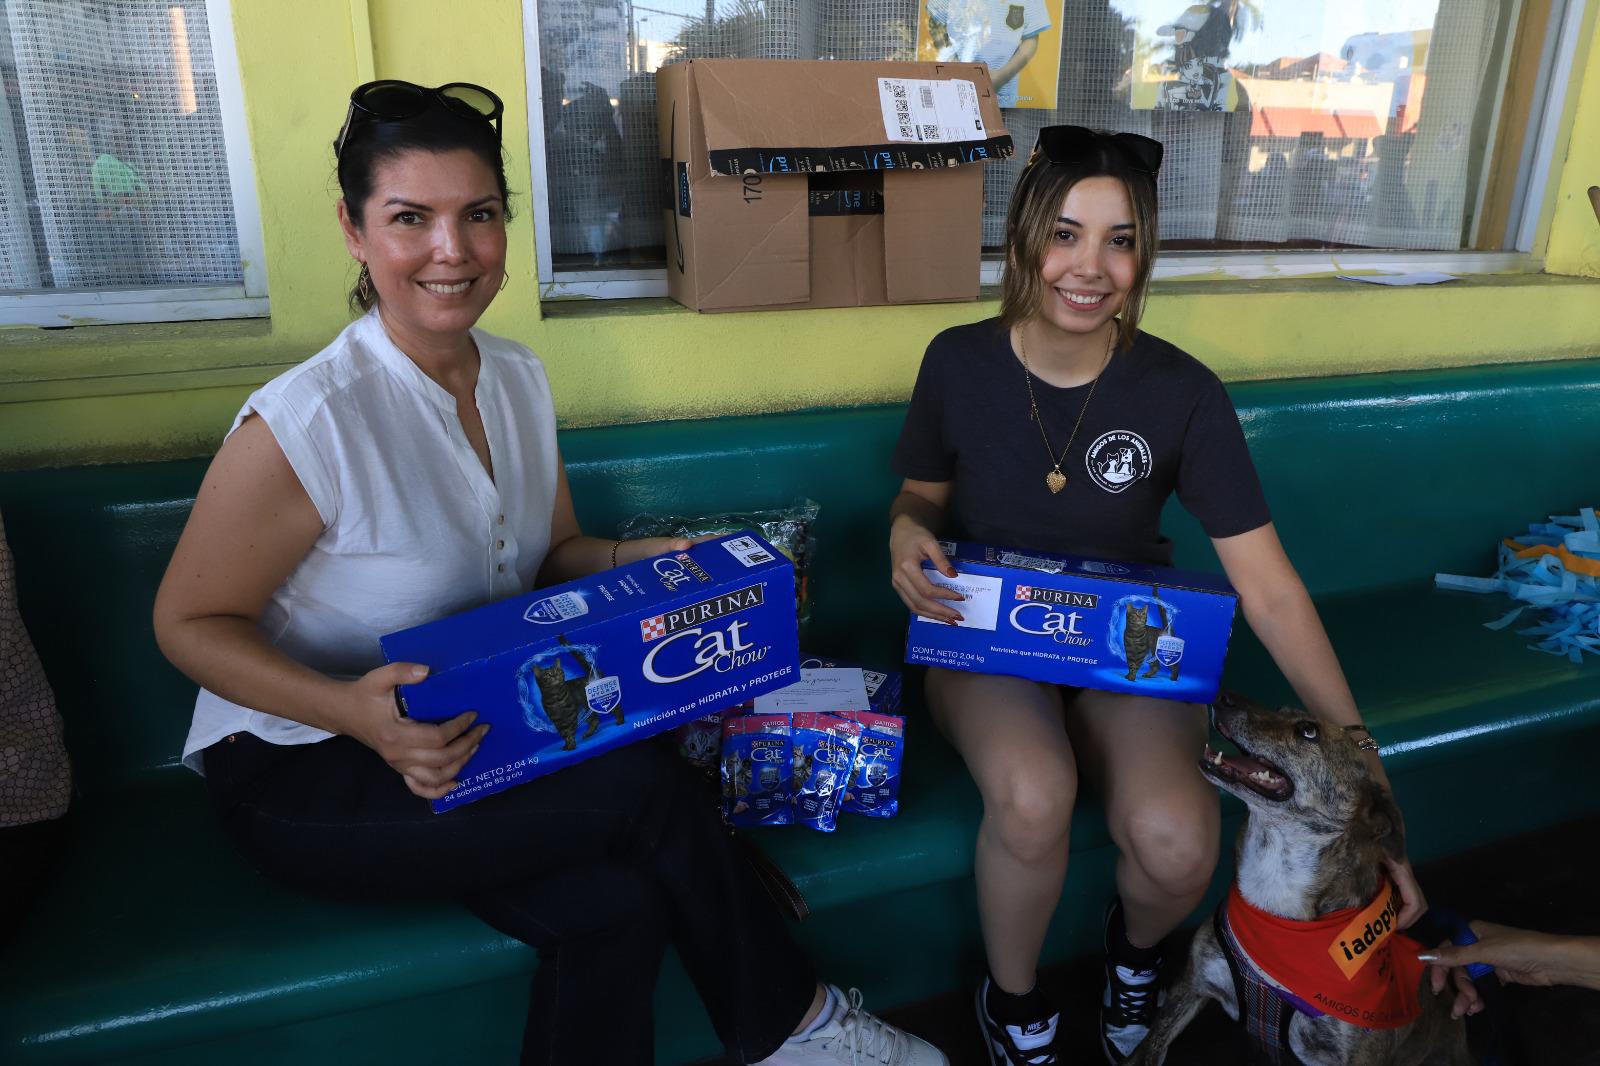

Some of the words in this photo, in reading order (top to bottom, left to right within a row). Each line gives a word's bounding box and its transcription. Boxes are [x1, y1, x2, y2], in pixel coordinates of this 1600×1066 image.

[743, 175, 762, 204] 170
[1091, 440, 1108, 458] AMIGOS
[1130, 438, 1147, 464] ANIMALES
[653, 558, 690, 586] Cat
[668, 588, 758, 630] PURINA
[1033, 589, 1094, 607] PURINA
[1009, 602, 1083, 634] Cat
[1053, 630, 1091, 647] Chow
[642, 619, 754, 684] Cat
[714, 646, 768, 673] Chow
[912, 646, 936, 656] CONT.
[938, 649, 959, 659] NETO
[976, 655, 985, 663] kg
[920, 655, 938, 663] sobres
[990, 646, 1018, 654] Nutrición
[1032, 651, 1060, 660] HIDRATA
[1067, 656, 1098, 665] PROTEGE
[588, 680, 617, 694] DEFENSE
[633, 708, 677, 729] Nutrición
[679, 701, 696, 714] que
[698, 684, 740, 706] HIDRATA
[742, 683, 747, 692] y
[749, 666, 792, 688] PROTEGE
[860, 744, 891, 757] Cat
[869, 738, 895, 747] PURINA
[751, 748, 783, 761] Cat
[476, 767, 504, 782] NETO
[506, 760, 526, 772] 2.04
[528, 756, 539, 764] kg
[444, 794, 454, 802] 24
[456, 784, 482, 798] sobres
[1313, 992, 1360, 1018] AMIGOS
